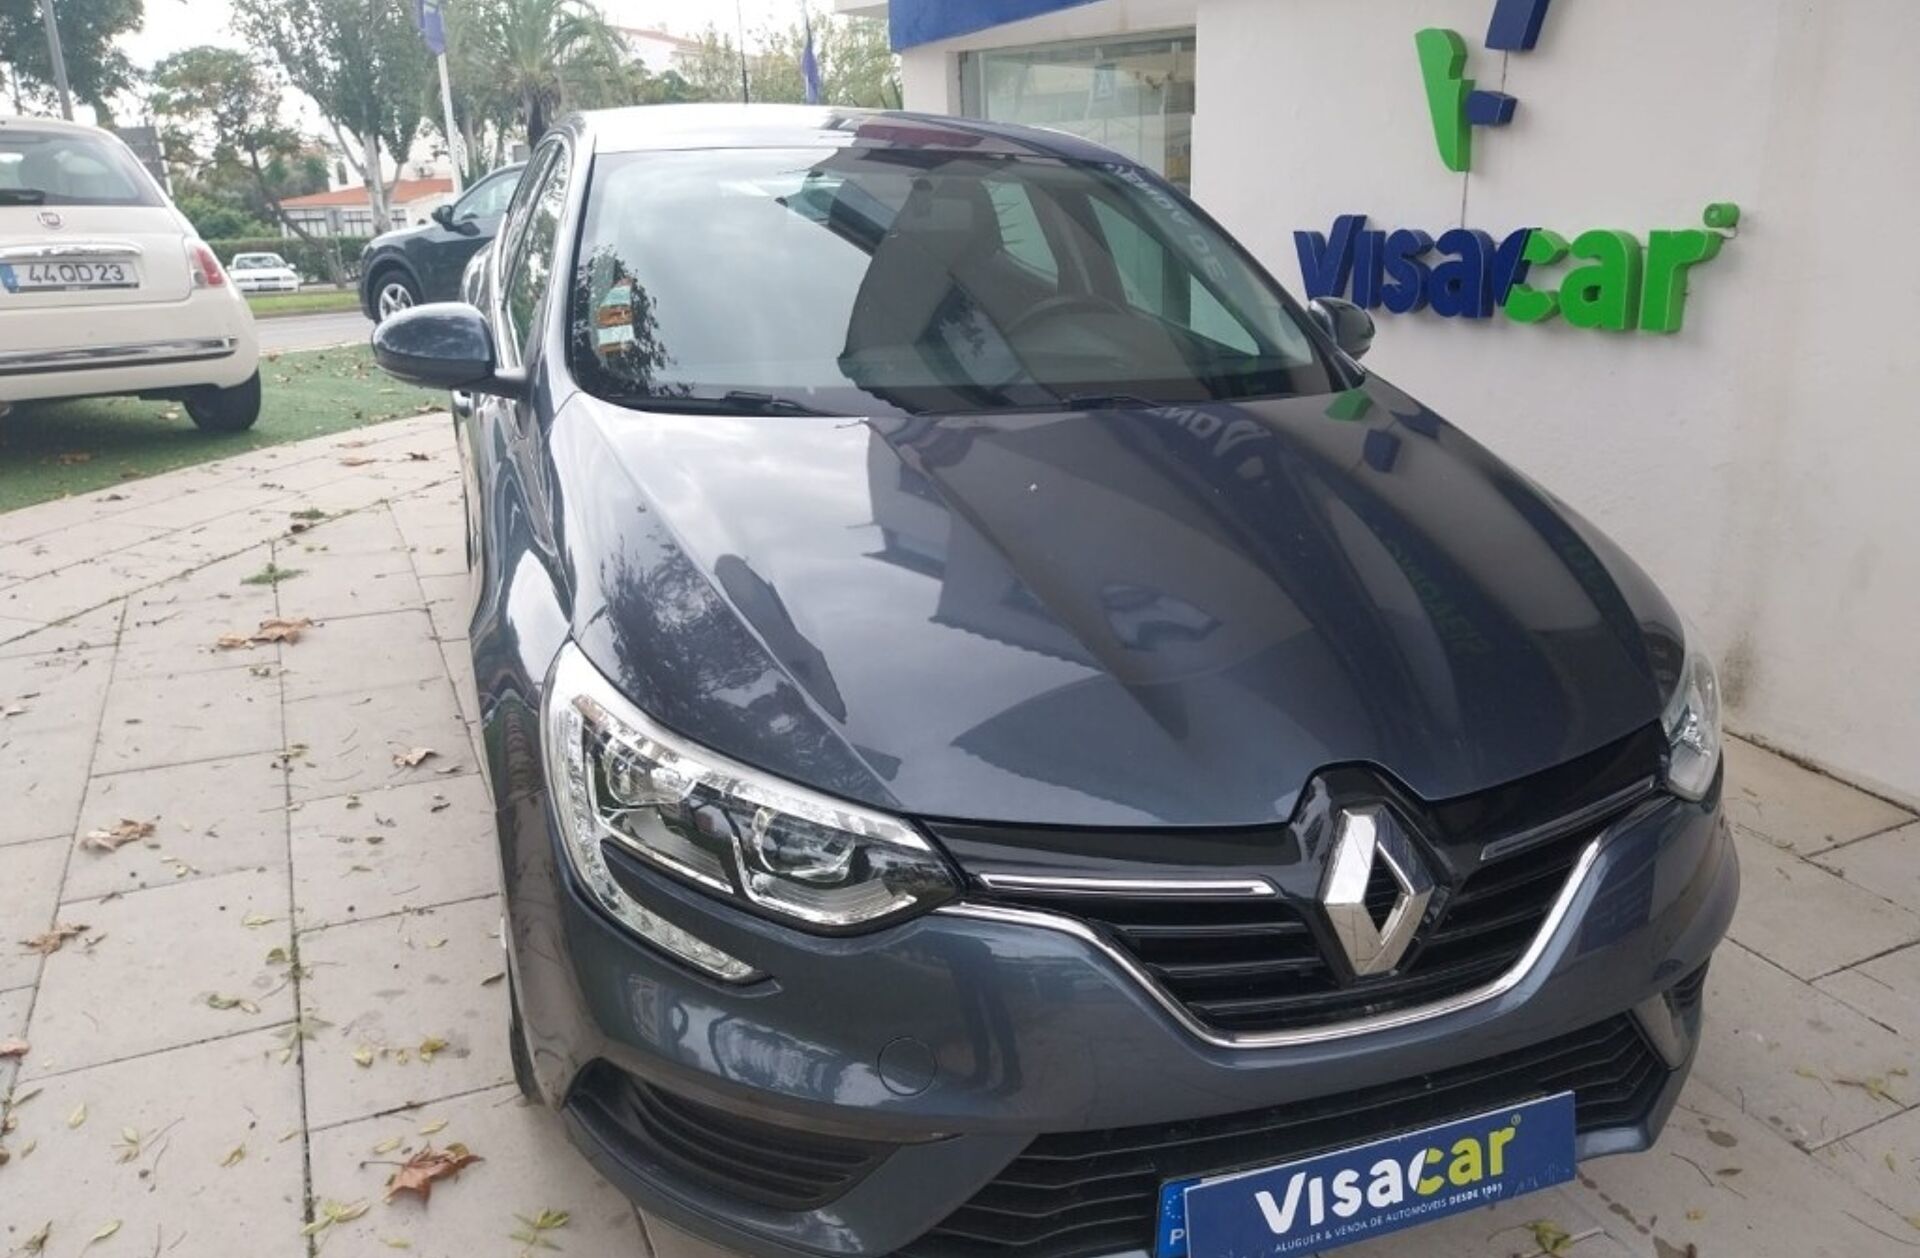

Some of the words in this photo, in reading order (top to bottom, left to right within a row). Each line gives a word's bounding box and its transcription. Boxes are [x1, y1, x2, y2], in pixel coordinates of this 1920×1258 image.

[1169, 1228, 1185, 1246] P
[1274, 1232, 1323, 1253] ALUGUER
[1325, 1230, 1333, 1240] &
[1334, 1221, 1368, 1238] VENDA
[1370, 1215, 1383, 1227] DE
[1448, 1188, 1479, 1206] DESDE
